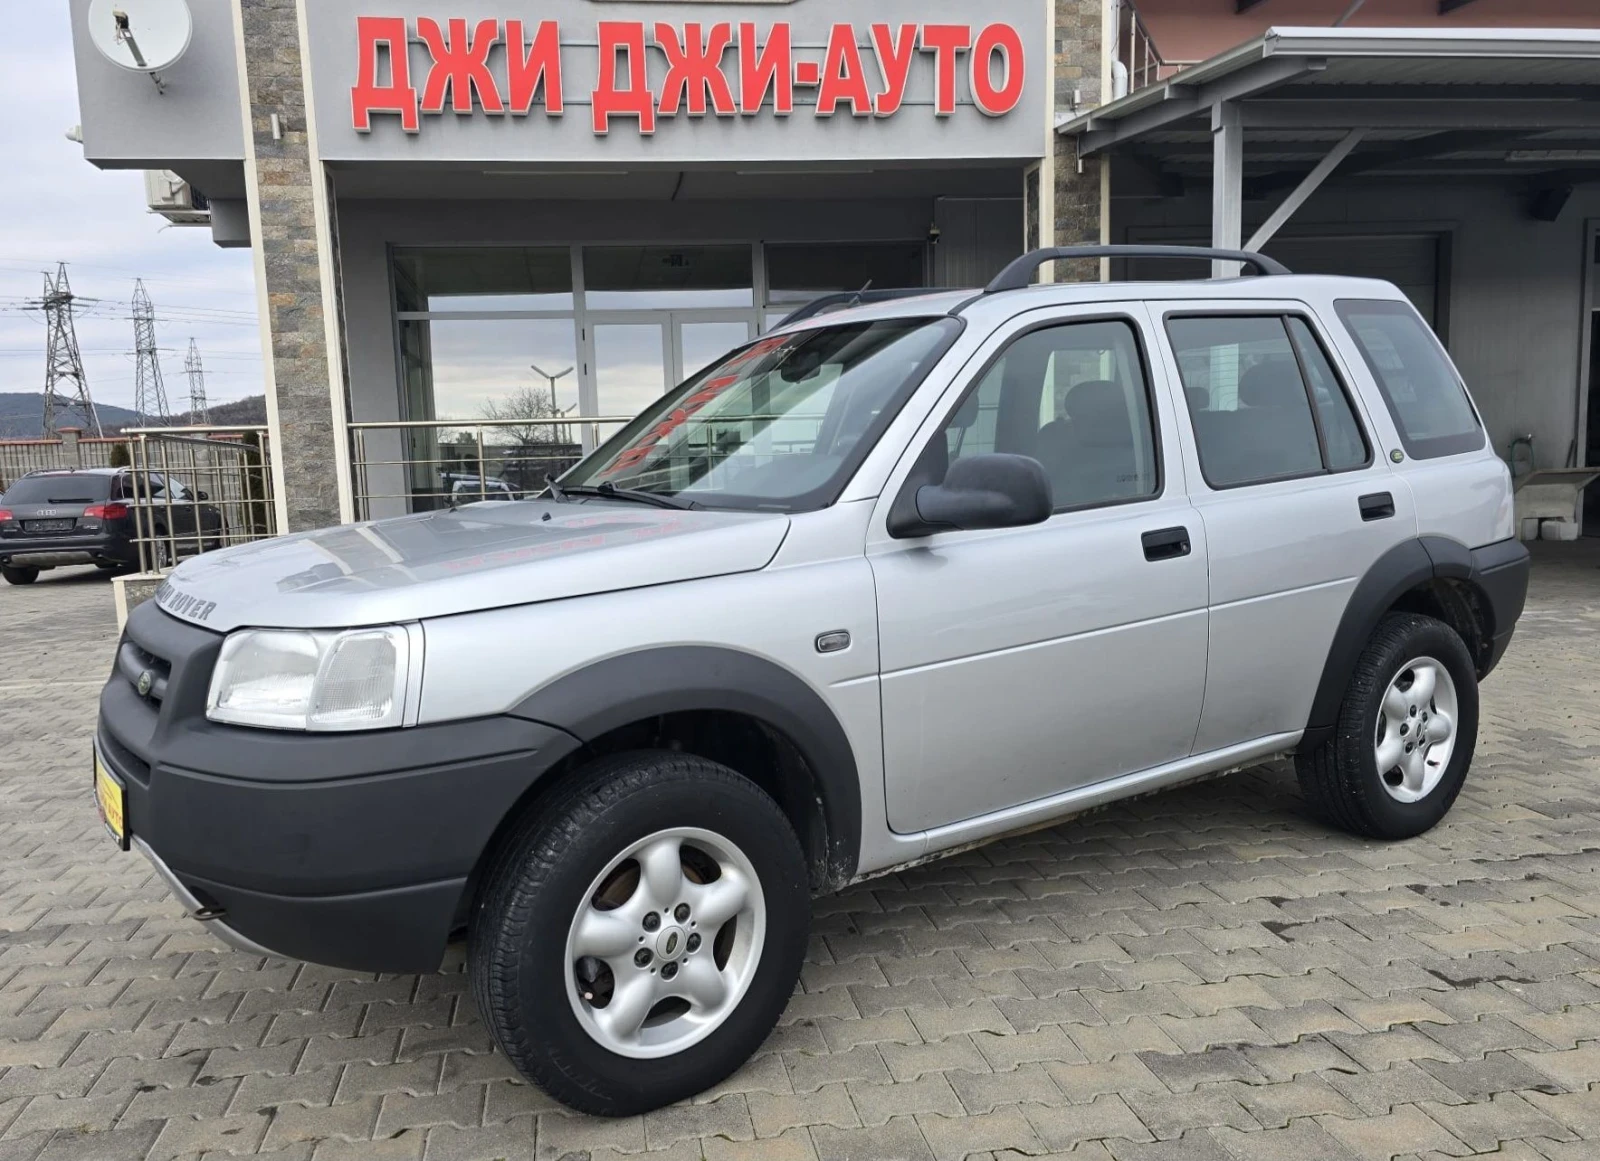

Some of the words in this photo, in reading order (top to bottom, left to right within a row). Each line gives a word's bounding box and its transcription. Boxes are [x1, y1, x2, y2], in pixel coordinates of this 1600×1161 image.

[351, 16, 564, 133] ДЖИ
[591, 21, 1026, 136] ДЖИ-АУТО
[168, 591, 217, 621] ROVER
